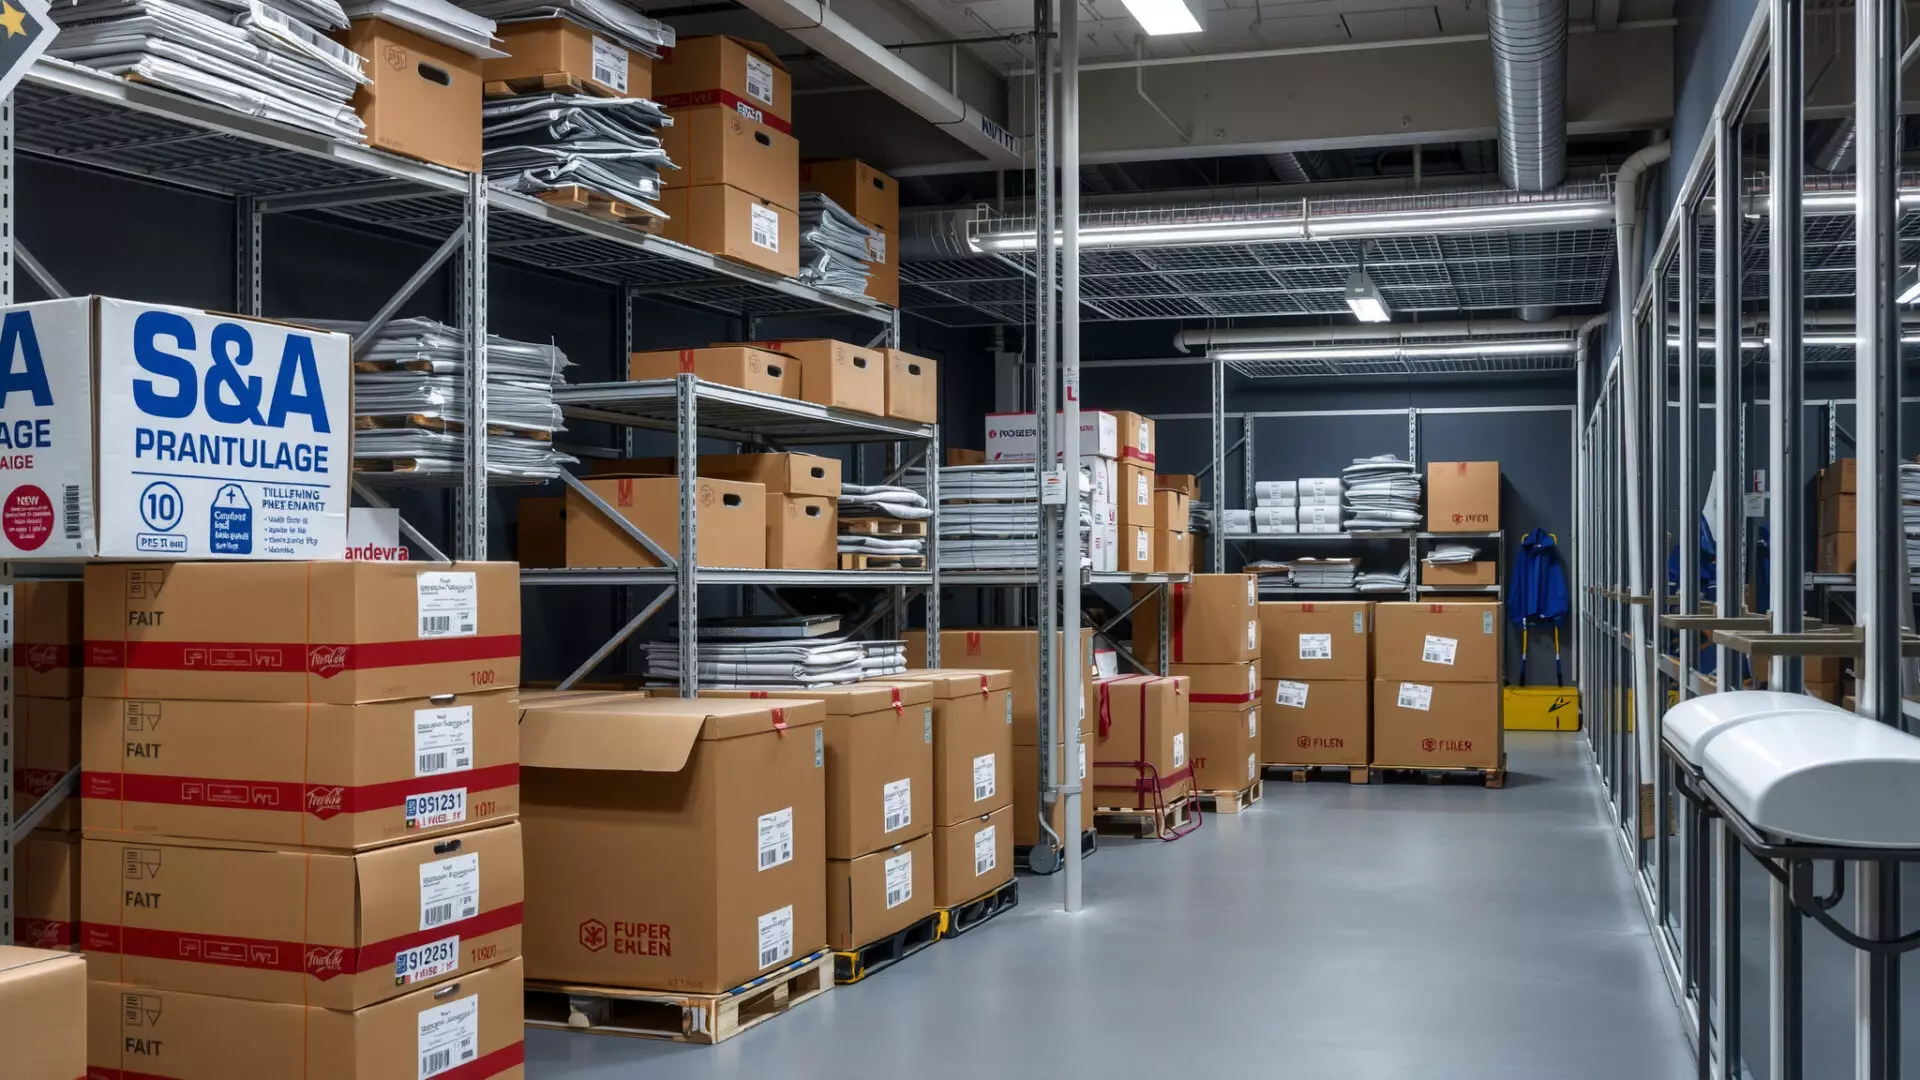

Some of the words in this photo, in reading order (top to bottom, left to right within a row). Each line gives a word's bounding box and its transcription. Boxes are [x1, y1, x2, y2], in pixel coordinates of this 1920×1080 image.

[132, 310, 331, 434] S&A
[135, 427, 329, 474] PRANTULAGE
[147, 493, 175, 521] 10
[344, 542, 410, 561] andevra
[128, 610, 164, 627] FAIT
[126, 742, 162, 759] FAIT
[125, 890, 162, 909] FAIT
[613, 920, 672, 941] FUPER
[125, 1036, 163, 1057] FAIT
